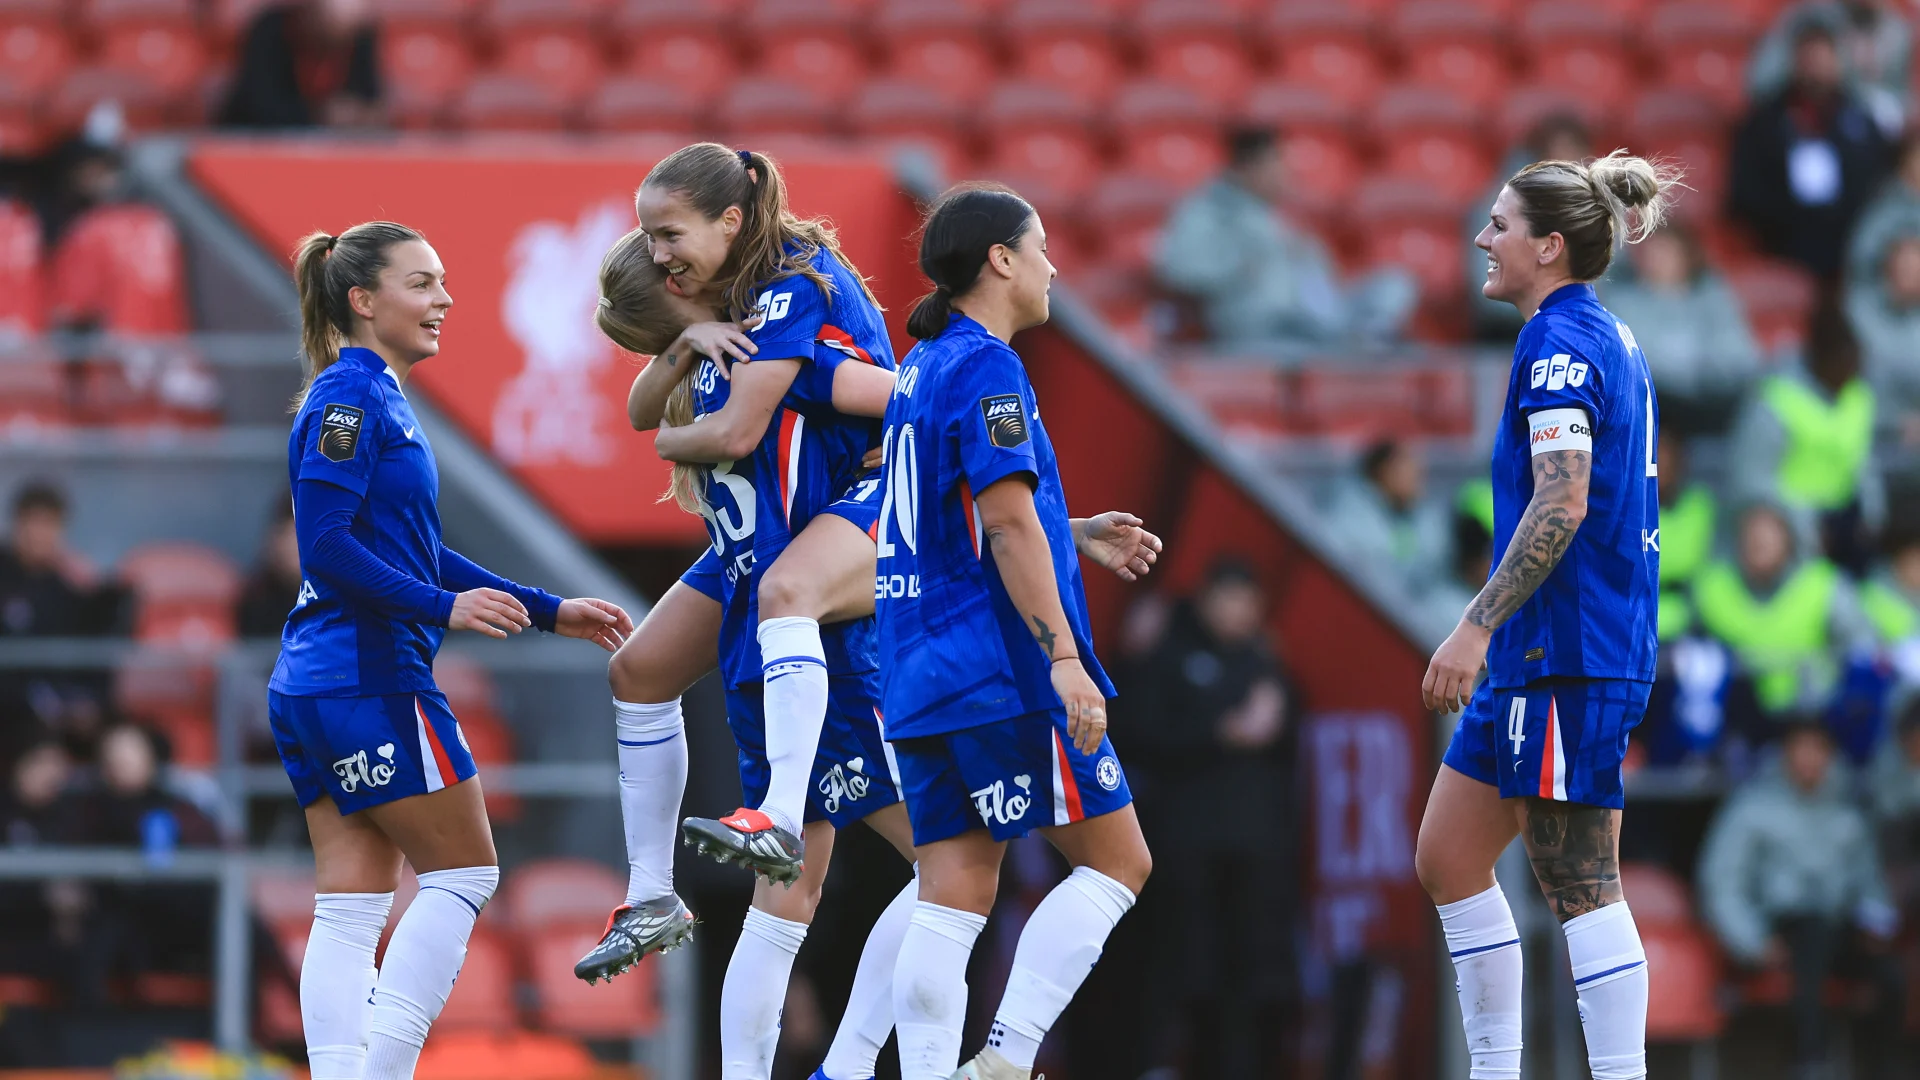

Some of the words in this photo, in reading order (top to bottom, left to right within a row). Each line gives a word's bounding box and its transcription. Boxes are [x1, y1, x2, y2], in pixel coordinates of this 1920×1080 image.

[1532, 358, 1587, 388] FPT
[326, 412, 359, 427] WSL
[987, 402, 1020, 417] WSL
[1531, 426, 1562, 446] WSL
[877, 423, 918, 558] 20
[1508, 697, 1527, 754] 4
[333, 748, 396, 793] Flo
[819, 762, 869, 814] Flo
[970, 779, 1031, 827] Flo
